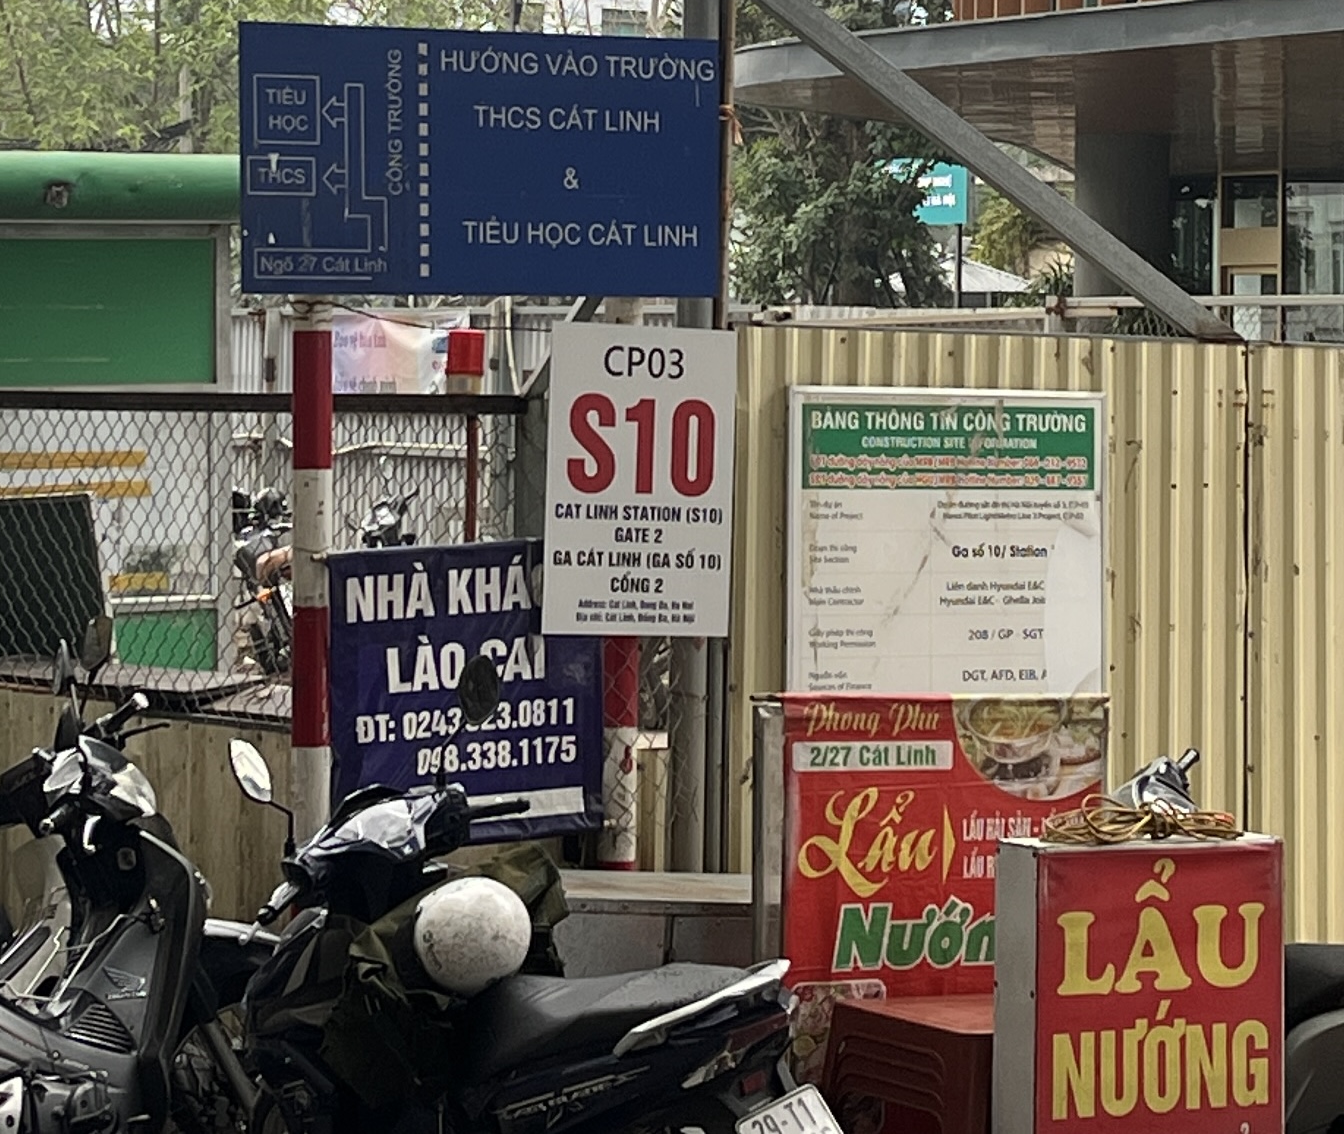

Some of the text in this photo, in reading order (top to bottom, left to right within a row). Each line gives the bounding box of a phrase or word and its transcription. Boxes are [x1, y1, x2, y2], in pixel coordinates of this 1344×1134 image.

[441, 45, 716, 82] HƯỚNG VÀO TRƯỜNG
[265, 83, 306, 106] TIỂU
[268, 115, 309, 134] HỌC
[385, 48, 404, 196] CÔNG TRƯỜNG
[474, 103, 660, 134] THCS CÁT LINH
[258, 167, 305, 185] THCS
[563, 168, 579, 191] &
[462, 215, 698, 250] TIỂU HỌC CÁT LINH
[298, 257, 317, 273] 27
[322, 256, 350, 273] Cát
[354, 257, 387, 273] Linh
[604, 345, 685, 380] CP03
[811, 406, 1086, 433] BẢNG THÔNG TIN CÔNG TRƯỜNG
[567, 392, 716, 497] S10
[861, 436, 1037, 449] CONSTRUCTION SITE ORATION
[555, 503, 723, 525] CAT LINH STATION (S10)
[614, 527, 663, 543] GATE 2
[952, 545, 968, 558] Ga
[972, 542, 985, 558] số
[1010, 545, 1047, 558] Station
[553, 547, 722, 571] GA CÁT LINH (GA SỐ 10)
[346, 561, 436, 624] NHÀ
[610, 571, 663, 593] CỔNG 2
[386, 634, 465, 694] LÀO
[356, 697, 575, 744] ĐT: 0243.3.0811
[804, 700, 942, 737] Phong Phú
[416, 735, 577, 776] 098.338.1175
[810, 743, 937, 768] 2/27 Cát Linh
[798, 787, 938, 898] Lẩu
[832, 895, 995, 974] Nướn
[1057, 857, 1265, 997] LẨU
[1051, 1000, 1270, 1121] NƯỚNG
